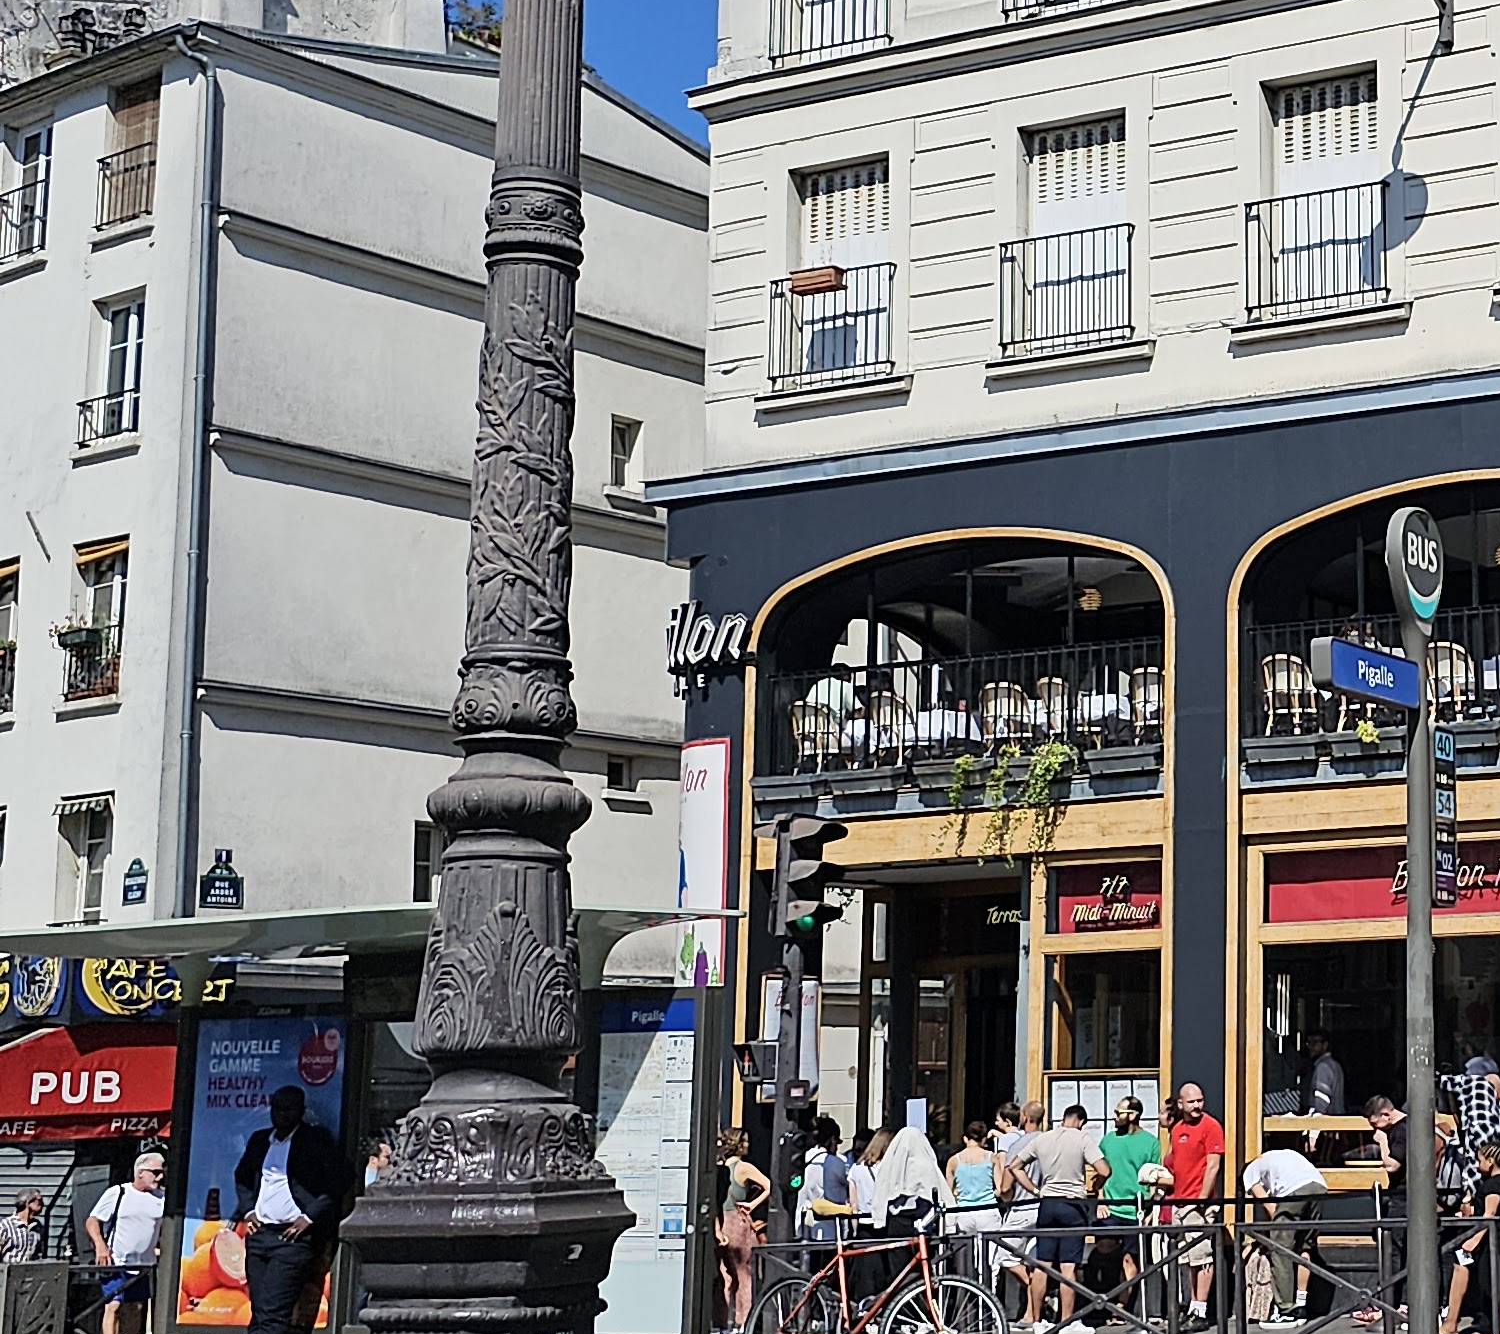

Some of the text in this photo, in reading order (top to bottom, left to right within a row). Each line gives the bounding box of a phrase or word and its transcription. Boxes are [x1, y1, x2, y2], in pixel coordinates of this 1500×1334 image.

[1408, 531, 1438, 573] BUS
[1357, 659, 1394, 687] Pigalle
[1436, 733, 1451, 758] 40
[1437, 792, 1452, 815] 54
[1100, 874, 1130, 898] 7/7
[631, 1010, 666, 1024] Pigalle
[210, 1039, 281, 1055] NOUVELLE
[209, 1058, 261, 1073] GAMME
[30, 1070, 121, 1105] PUB
[207, 1076, 267, 1090] HEALTHY
[207, 1094, 231, 1108] MIX
[110, 1116, 159, 1132] PIZZA
